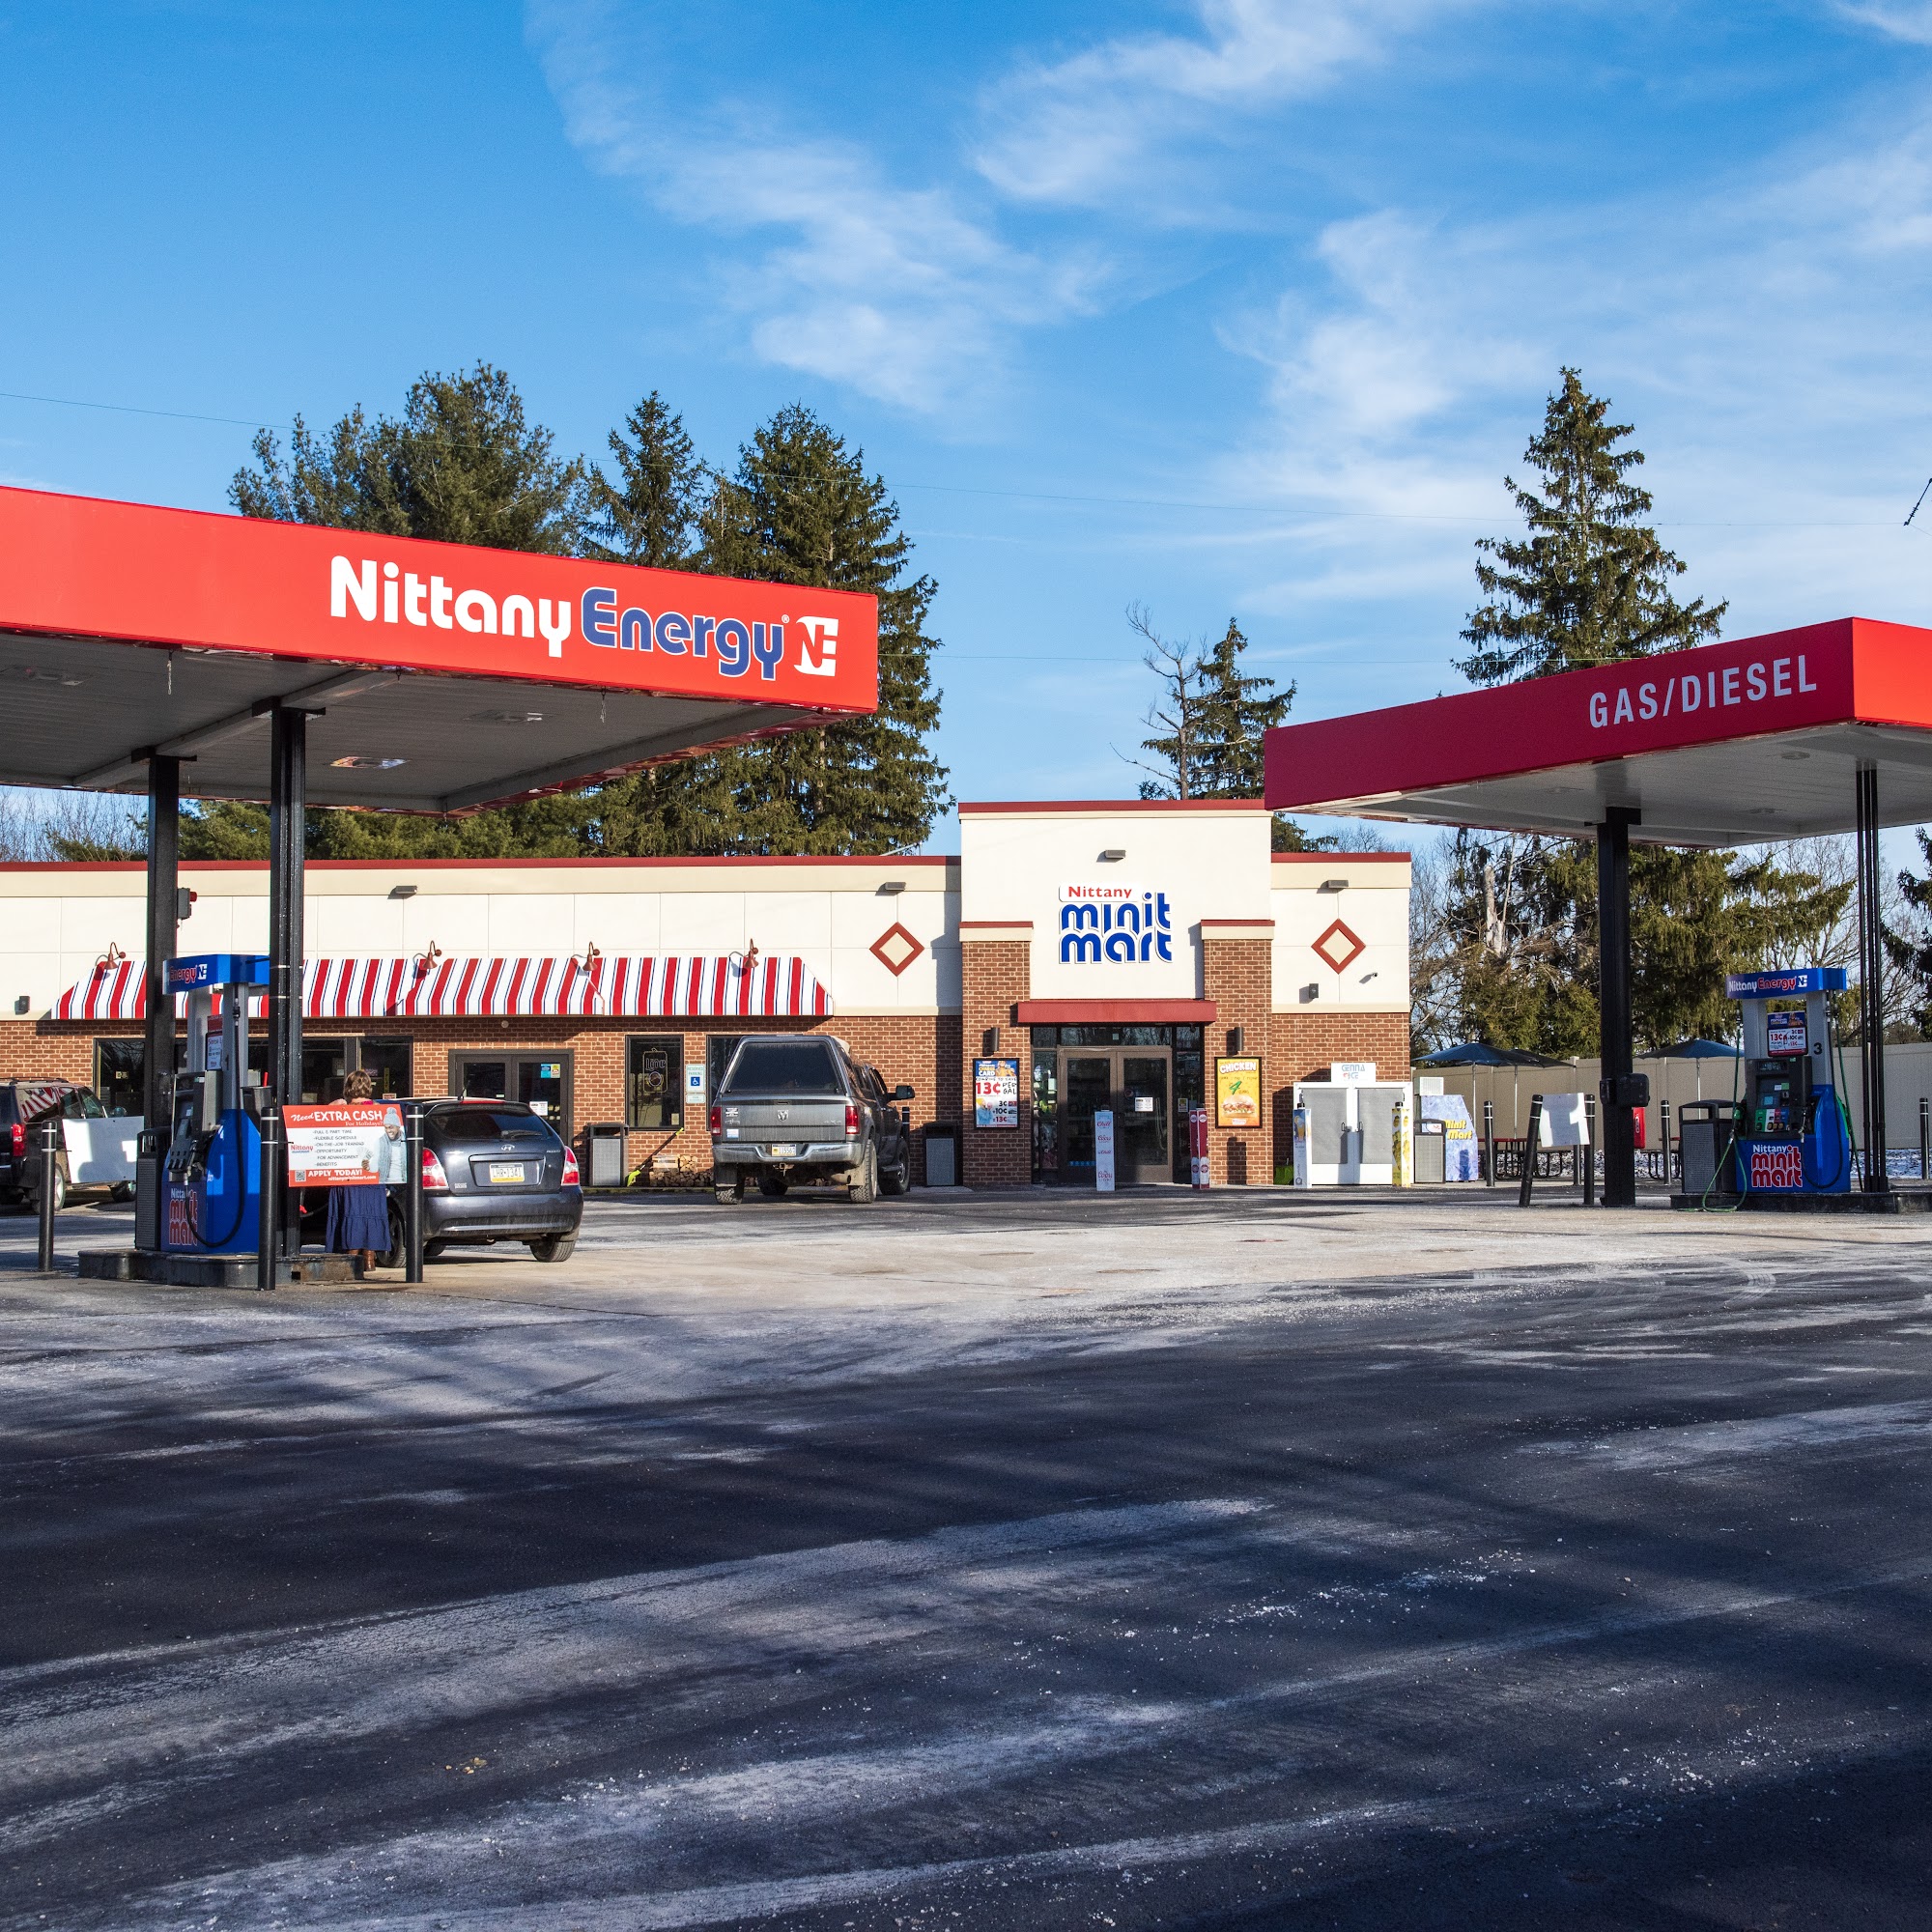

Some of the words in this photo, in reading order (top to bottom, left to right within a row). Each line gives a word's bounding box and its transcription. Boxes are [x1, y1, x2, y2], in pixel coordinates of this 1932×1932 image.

[330, 555, 571, 658] Nittany
[581, 585, 785, 681] Energy
[1589, 655, 1817, 728] GAS/DIESEL
[1068, 886, 1132, 898] Nittany
[1061, 892, 1171, 936] minit
[1061, 930, 1172, 963] mart
[169, 966, 197, 983] Energy
[1728, 980, 1757, 993] Nittany
[1757, 977, 1796, 991] Energy
[1813, 1042, 1823, 1055] 3
[1219, 1062, 1257, 1074] CHICKEN
[976, 1082, 1001, 1094] 13¢
[291, 1113, 314, 1122] Need
[314, 1111, 352, 1122] EXTRA
[353, 1110, 384, 1121] CASH
[1447, 1129, 1472, 1140] Mart
[1751, 1145, 1802, 1171] minit
[1751, 1167, 1804, 1188] mart
[171, 1188, 191, 1199] Nitta
